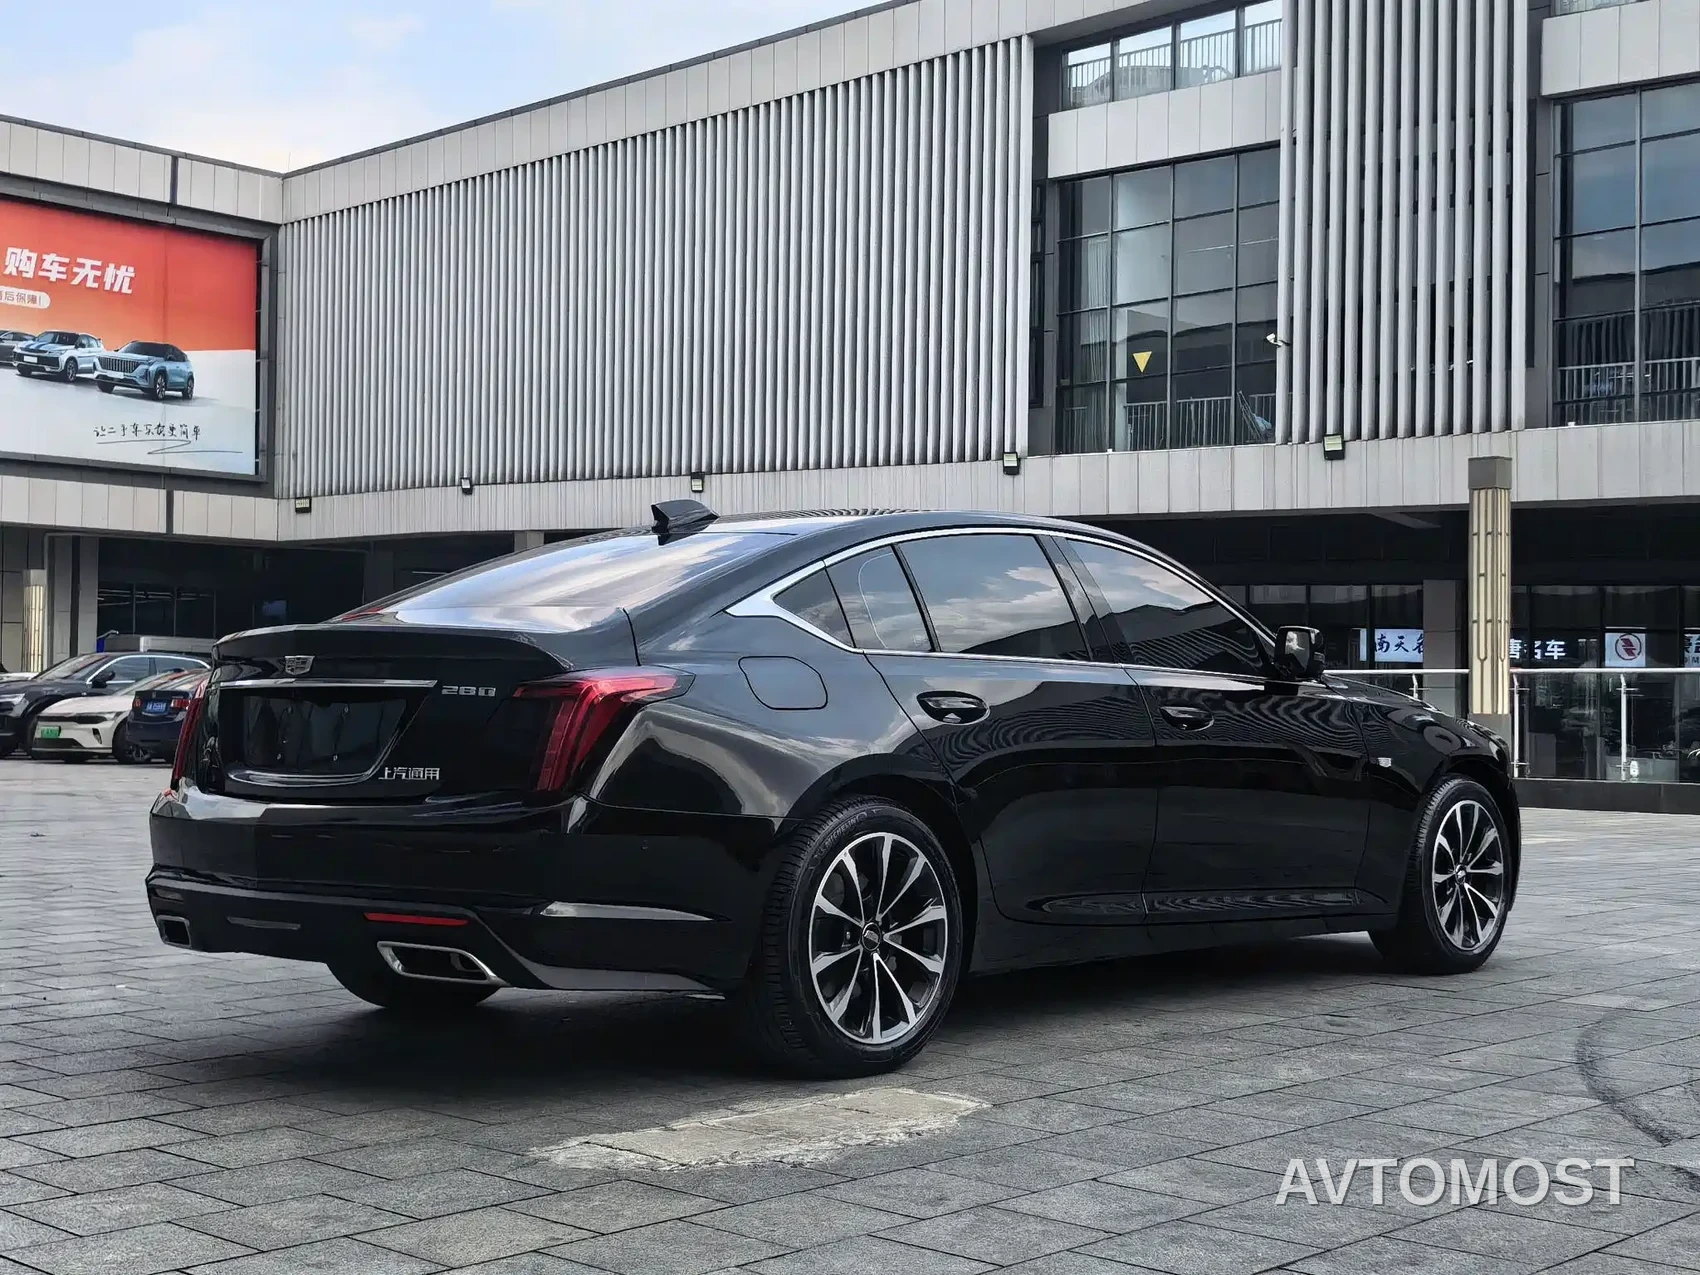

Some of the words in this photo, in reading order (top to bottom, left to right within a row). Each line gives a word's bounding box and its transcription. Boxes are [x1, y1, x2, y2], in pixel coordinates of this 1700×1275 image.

[3, 247, 136, 294] 购车无忧
[0, 290, 42, 306] 后保障!
[441, 685, 497, 697] 280
[378, 766, 441, 781] 上汽通用
